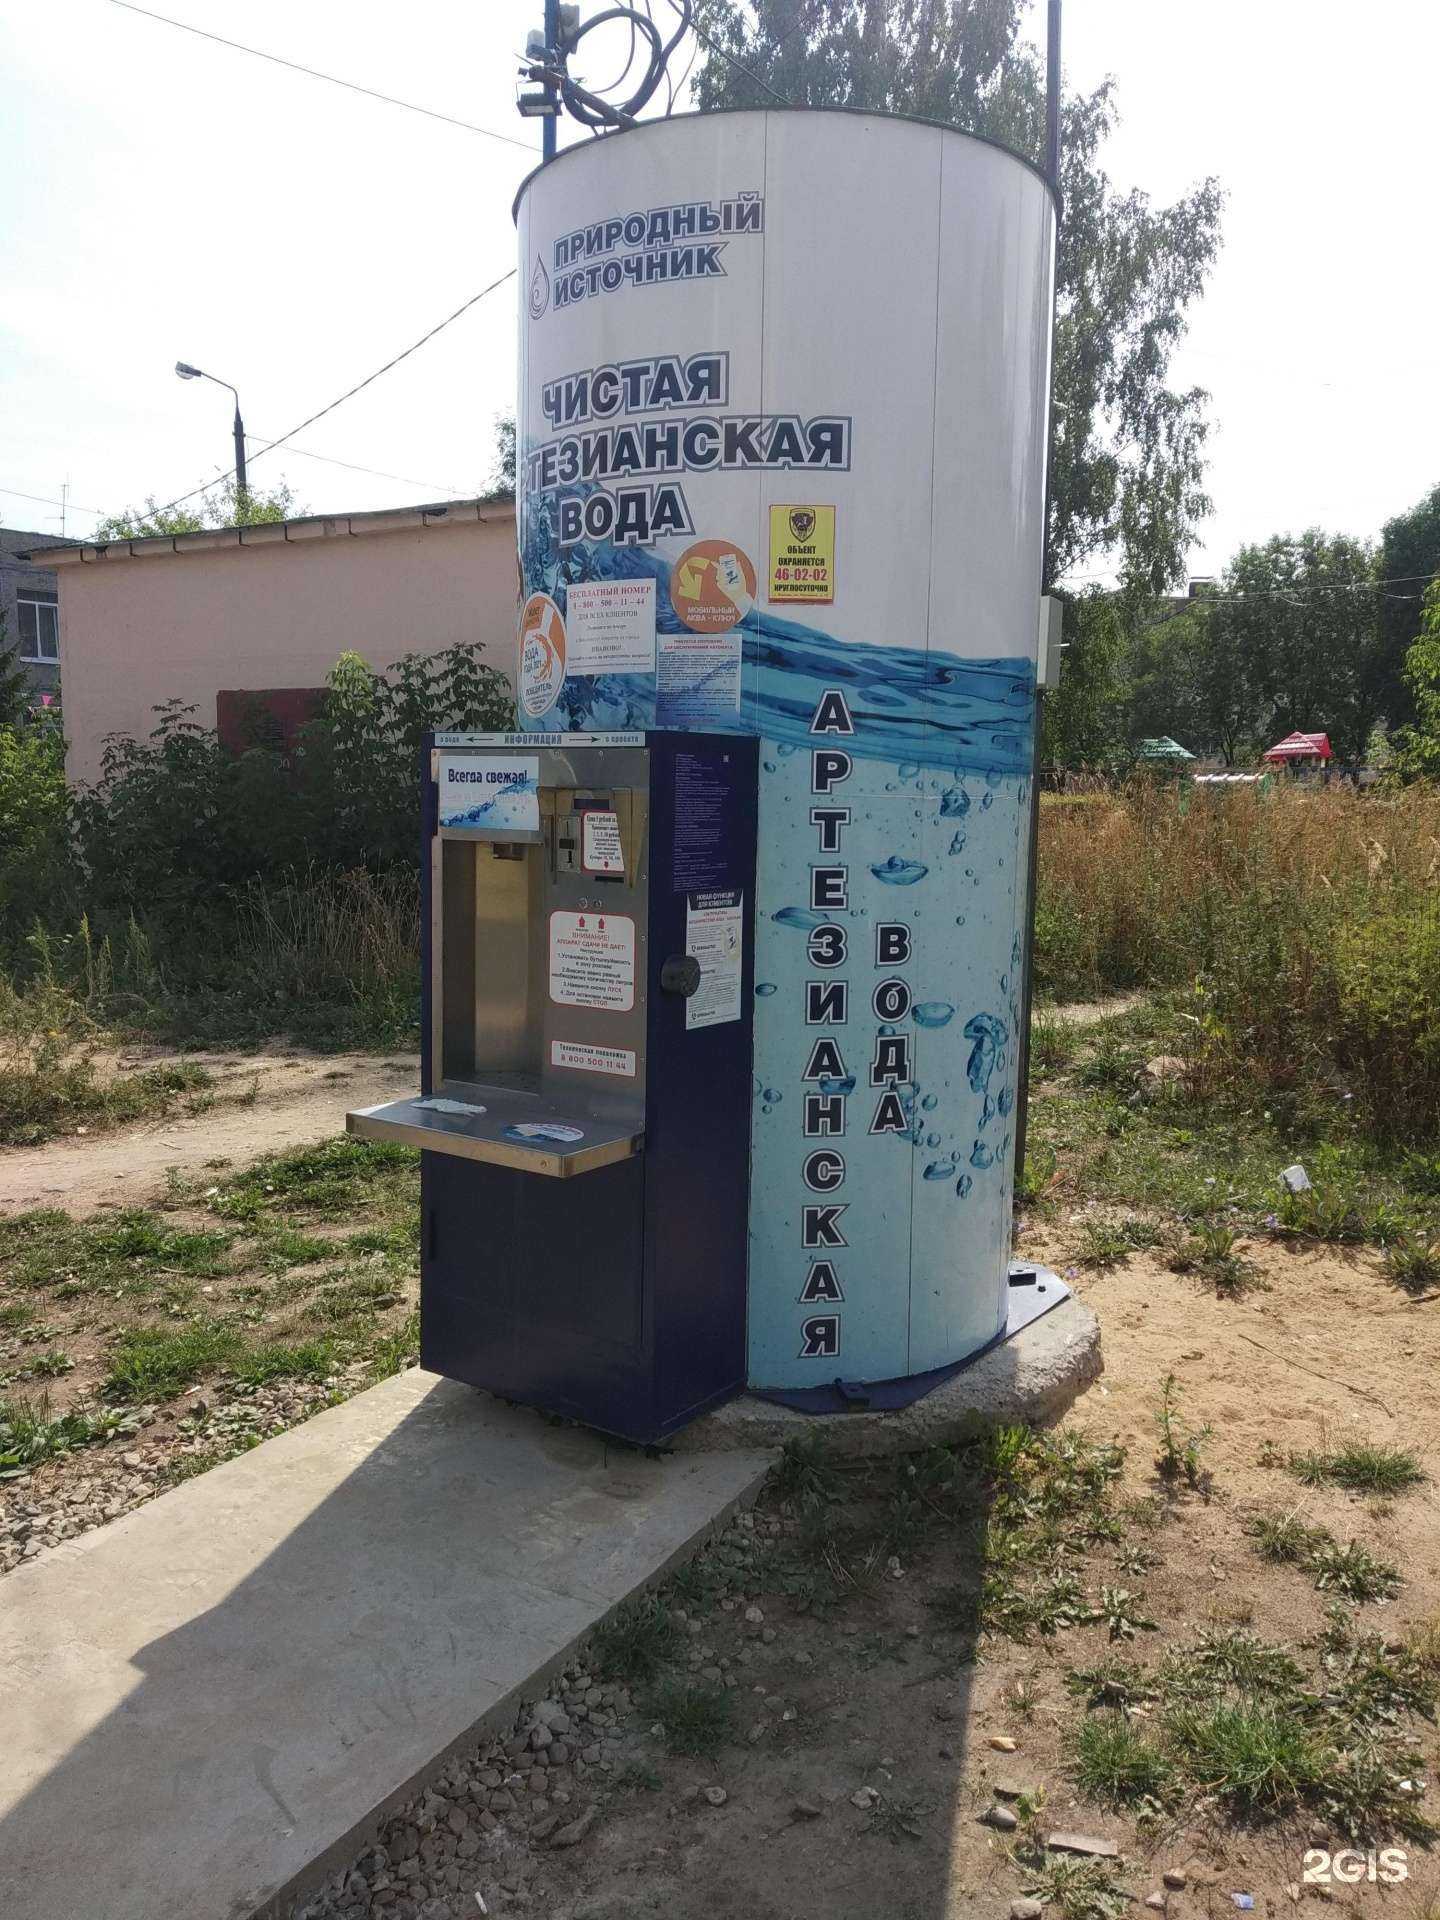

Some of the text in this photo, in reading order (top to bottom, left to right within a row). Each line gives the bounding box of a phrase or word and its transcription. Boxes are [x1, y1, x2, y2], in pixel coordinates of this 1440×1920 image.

[552, 190, 765, 272] ПРИРОДНЫЙ
[552, 241, 729, 312] ИСТОЧНИК
[542, 351, 730, 432] ЧИСТАЯ
[525, 415, 852, 495] ТЕЗИАНСКАЯ
[558, 481, 696, 548] ВОДА
[775, 568, 828, 581] 46-02-02
[778, 557, 825, 566] ОХРАНЯЕТСЯ
[569, 585, 651, 600] БЕСПЛАТНЫЙ НОМЕР
[774, 584, 828, 593] КРУГЛОСУТОЧНО
[504, 734, 562, 747] ИНФОРМАЦИЯ
[448, 768, 528, 785] Всегда свежая!
[803, 688, 856, 1361] АРТЕЗИАНСКАЯ
[868, 922, 914, 1136] ВОДА
[587, 1057, 603, 1067] 500
